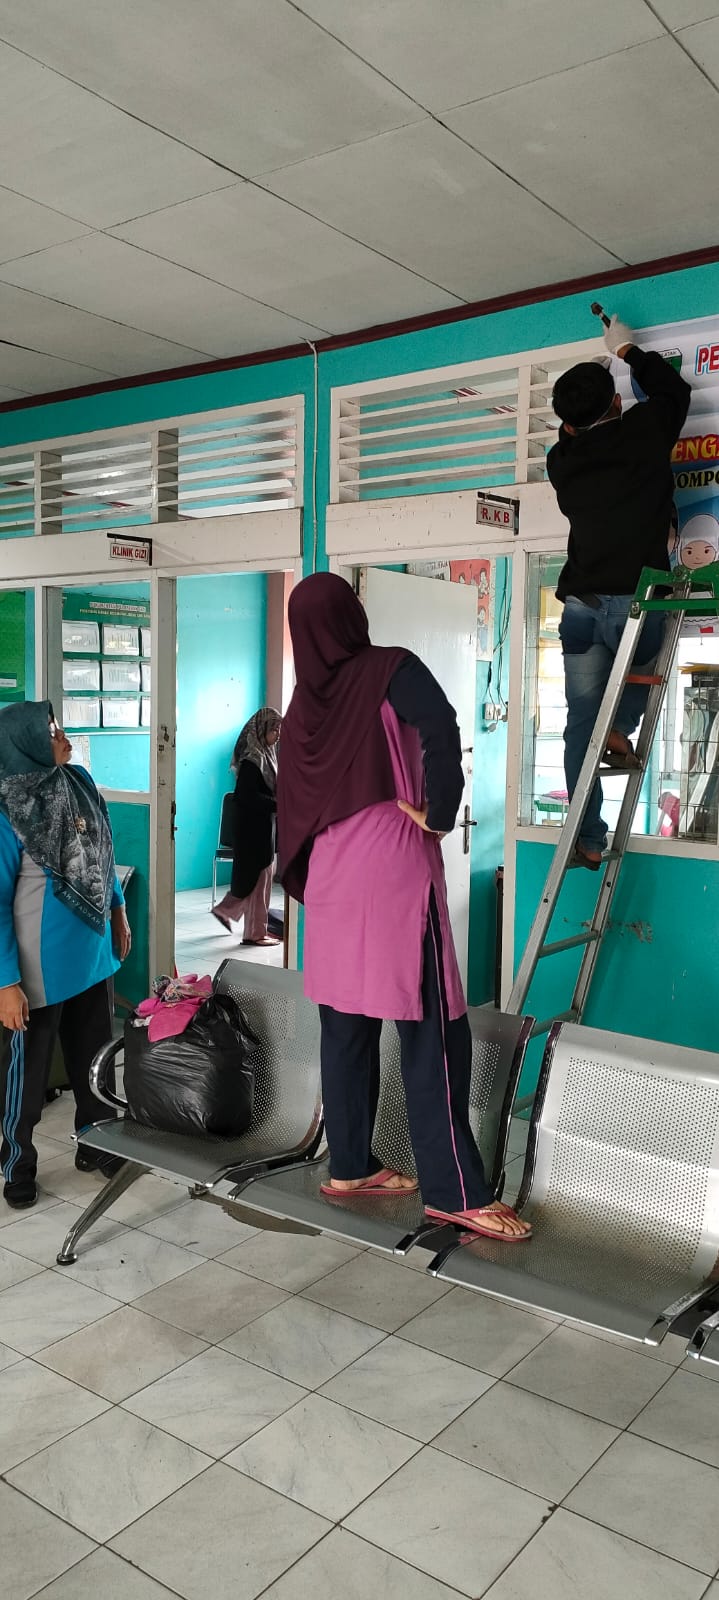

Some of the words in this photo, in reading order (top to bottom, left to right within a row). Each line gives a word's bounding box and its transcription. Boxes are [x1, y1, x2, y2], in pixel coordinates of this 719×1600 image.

[697, 344, 719, 373] PE
[112, 545, 133, 557] KLINIK
[134, 549, 147, 559] GIZI
